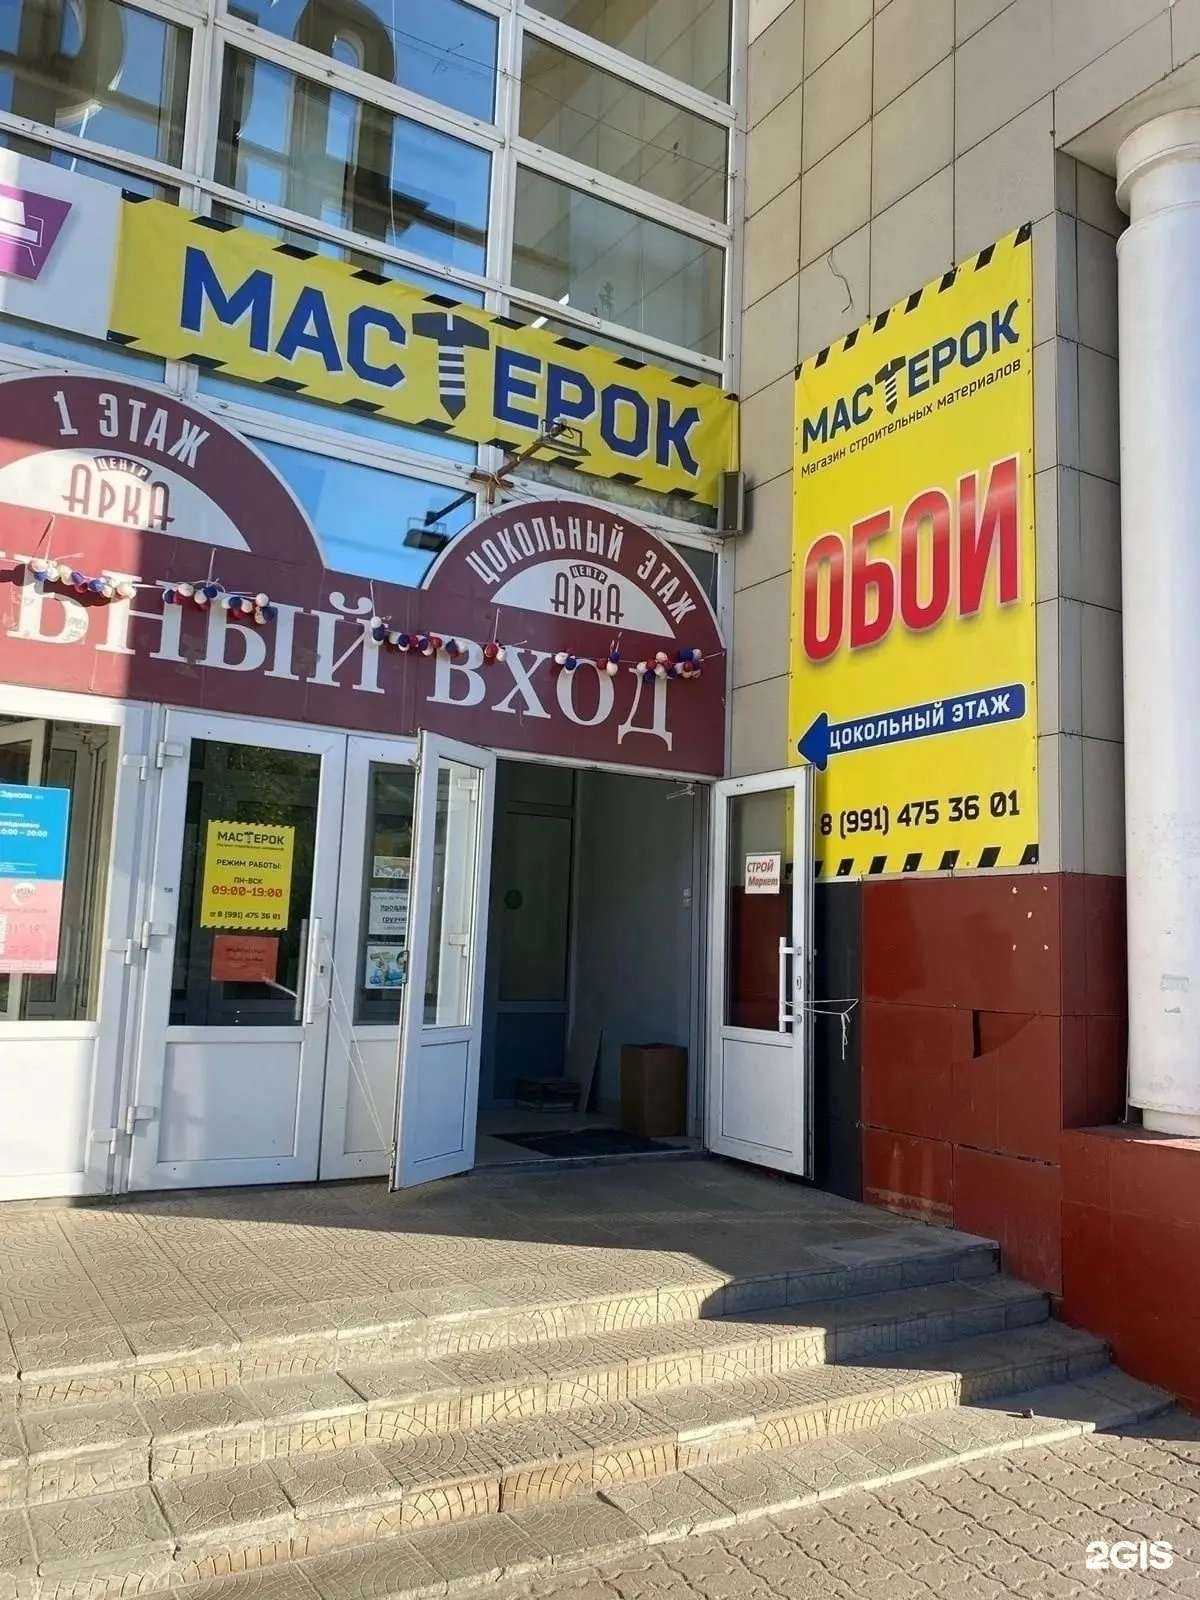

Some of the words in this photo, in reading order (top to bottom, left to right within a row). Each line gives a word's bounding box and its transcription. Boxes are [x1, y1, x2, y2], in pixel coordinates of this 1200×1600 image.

[180, 245, 700, 476] МАСТЕРОК
[801, 299, 1019, 454] МАСТЕРОК
[53, 390, 79, 436] 1
[98, 392, 211, 469] ЭТАЖ
[801, 447, 846, 478] Магазин
[849, 402, 933, 453] строительных
[936, 359, 1021, 410] материалов
[95, 455, 152, 480] ЦЕНТР
[61, 463, 175, 531] АРКА
[464, 515, 624, 585] ЦОКОЛЬНЫЙ
[636, 549, 697, 624] ЭТАЖ
[570, 565, 608, 585] ЦЕНТР
[802, 455, 1019, 662] ОБОИ
[550, 571, 625, 626] АРКА
[0, 550, 387, 695] ЬНЫЙ
[426, 632, 673, 752] ВХОД
[829, 702, 944, 750] ЦОКОЛЬНЫЙ
[951, 692, 1010, 724] ЭТАЖ
[217, 831, 284, 845] МАСТЕРОК
[820, 813, 833, 836] 8
[840, 805, 889, 840] (991)
[897, 800, 940, 827] 475
[948, 795, 980, 822] 36
[989, 789, 1020, 818] 01
[216, 858, 246, 867] РЕЖИМ
[233, 876, 263, 885] ПН-ВСК
[747, 859, 774, 873] СТРОЙ
[211, 885, 283, 898] 09:00-19:00
[224, 911, 243, 919] (991)
[244, 911, 259, 919] 475
[260, 912, 271, 920] 36
